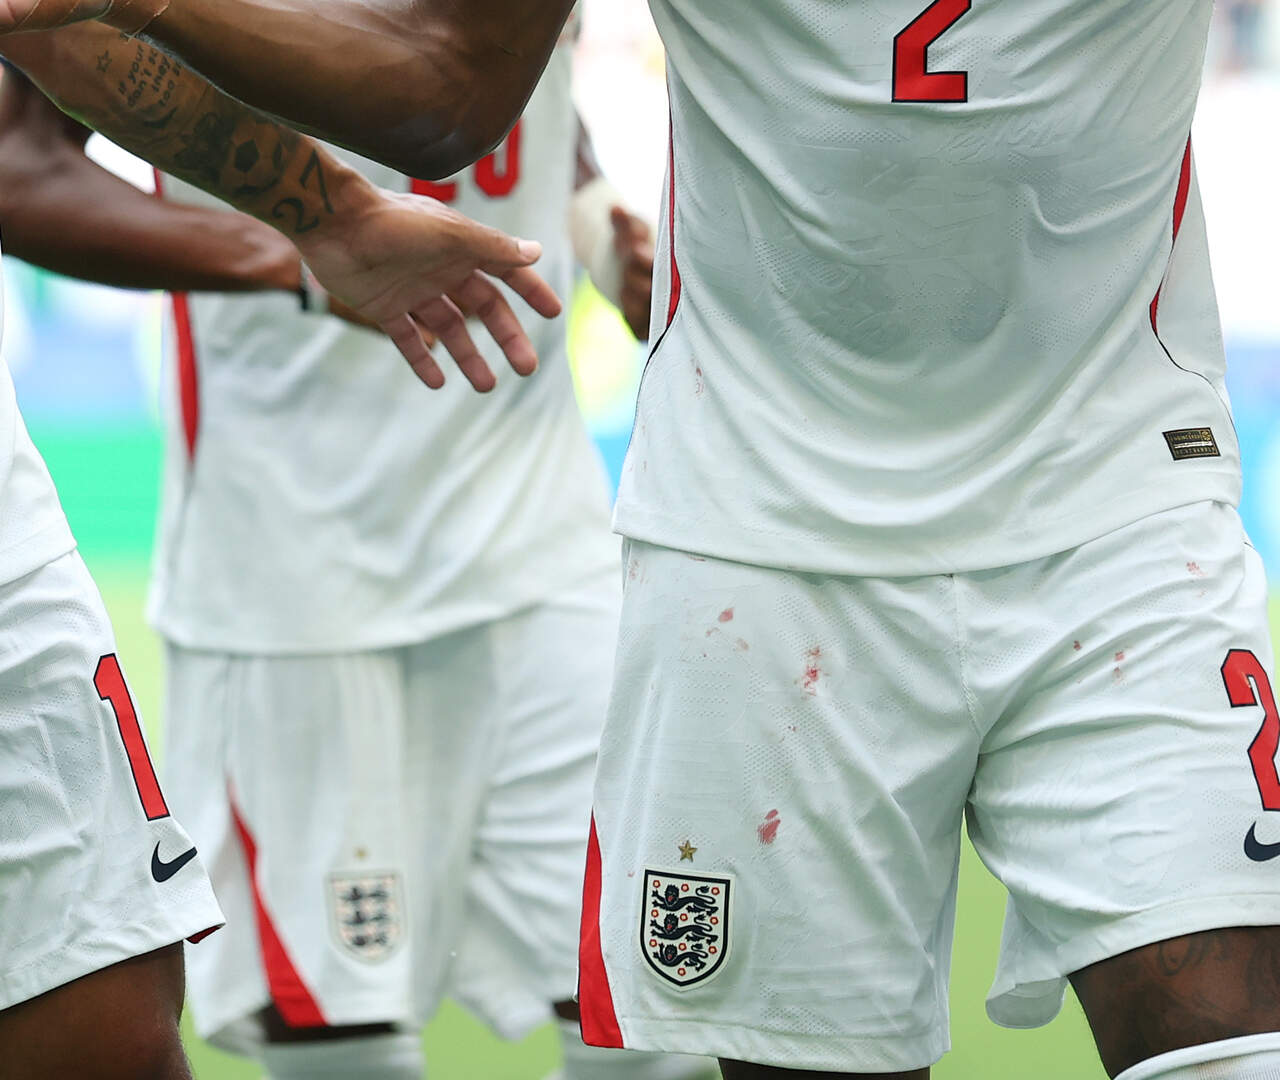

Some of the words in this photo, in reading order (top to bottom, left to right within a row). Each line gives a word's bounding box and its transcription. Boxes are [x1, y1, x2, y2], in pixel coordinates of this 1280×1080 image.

[128, 44, 144, 84] your
[272, 149, 335, 233] 27
[409, 117, 524, 203] 0
